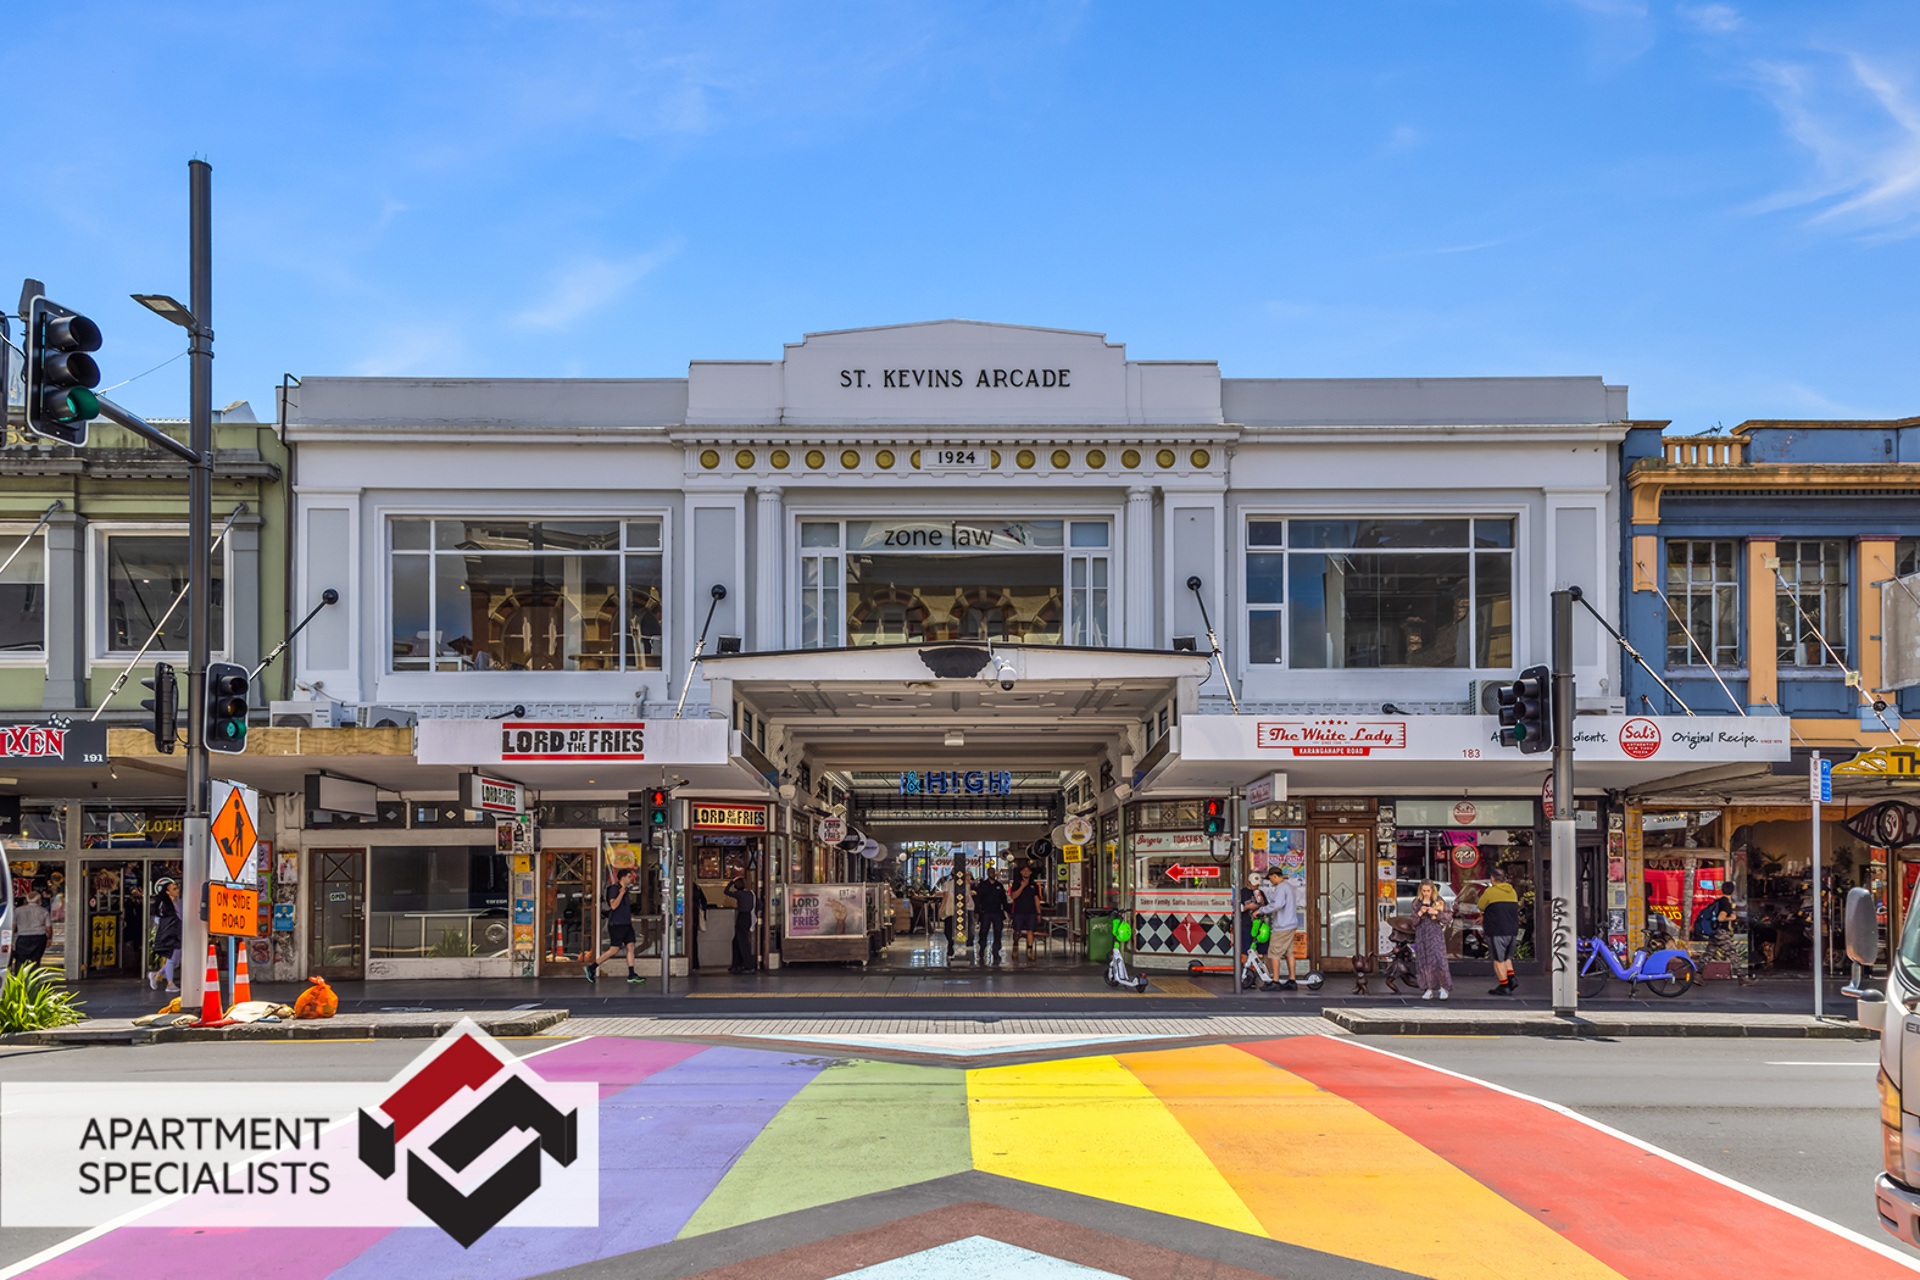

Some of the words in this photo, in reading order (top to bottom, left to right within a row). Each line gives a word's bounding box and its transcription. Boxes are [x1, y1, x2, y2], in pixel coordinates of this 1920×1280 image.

[840, 369, 872, 388] ST.
[883, 369, 963, 388] KEVINS
[976, 369, 1071, 388] ARCADE
[938, 451, 975, 464] 1924
[884, 529, 943, 546] zone
[951, 521, 994, 547] law
[569, 730, 586, 742] OF
[1269, 728, 1300, 741] The
[1302, 728, 1346, 741] White
[1350, 728, 1393, 745] Lady
[1625, 725, 1656, 739] Sal's
[502, 730, 565, 753] LORD
[567, 742, 587, 753] THE
[588, 730, 645, 753] FRIES
[1672, 731, 1714, 750] Original
[1718, 731, 1758, 747] Recipe.
[83, 753, 104, 763] 191
[1462, 749, 1481, 759] 183
[906, 770, 921, 795] &
[925, 770, 1005, 795] HIGH
[693, 808, 726, 824] LORD
[737, 810, 765, 826] FRIES
[1455, 849, 1477, 864] open
[216, 892, 229, 907] ON
[232, 894, 251, 910] SIDE
[792, 898, 820, 908] LORD
[222, 913, 246, 929] ROAD
[792, 916, 820, 926] FRIES
